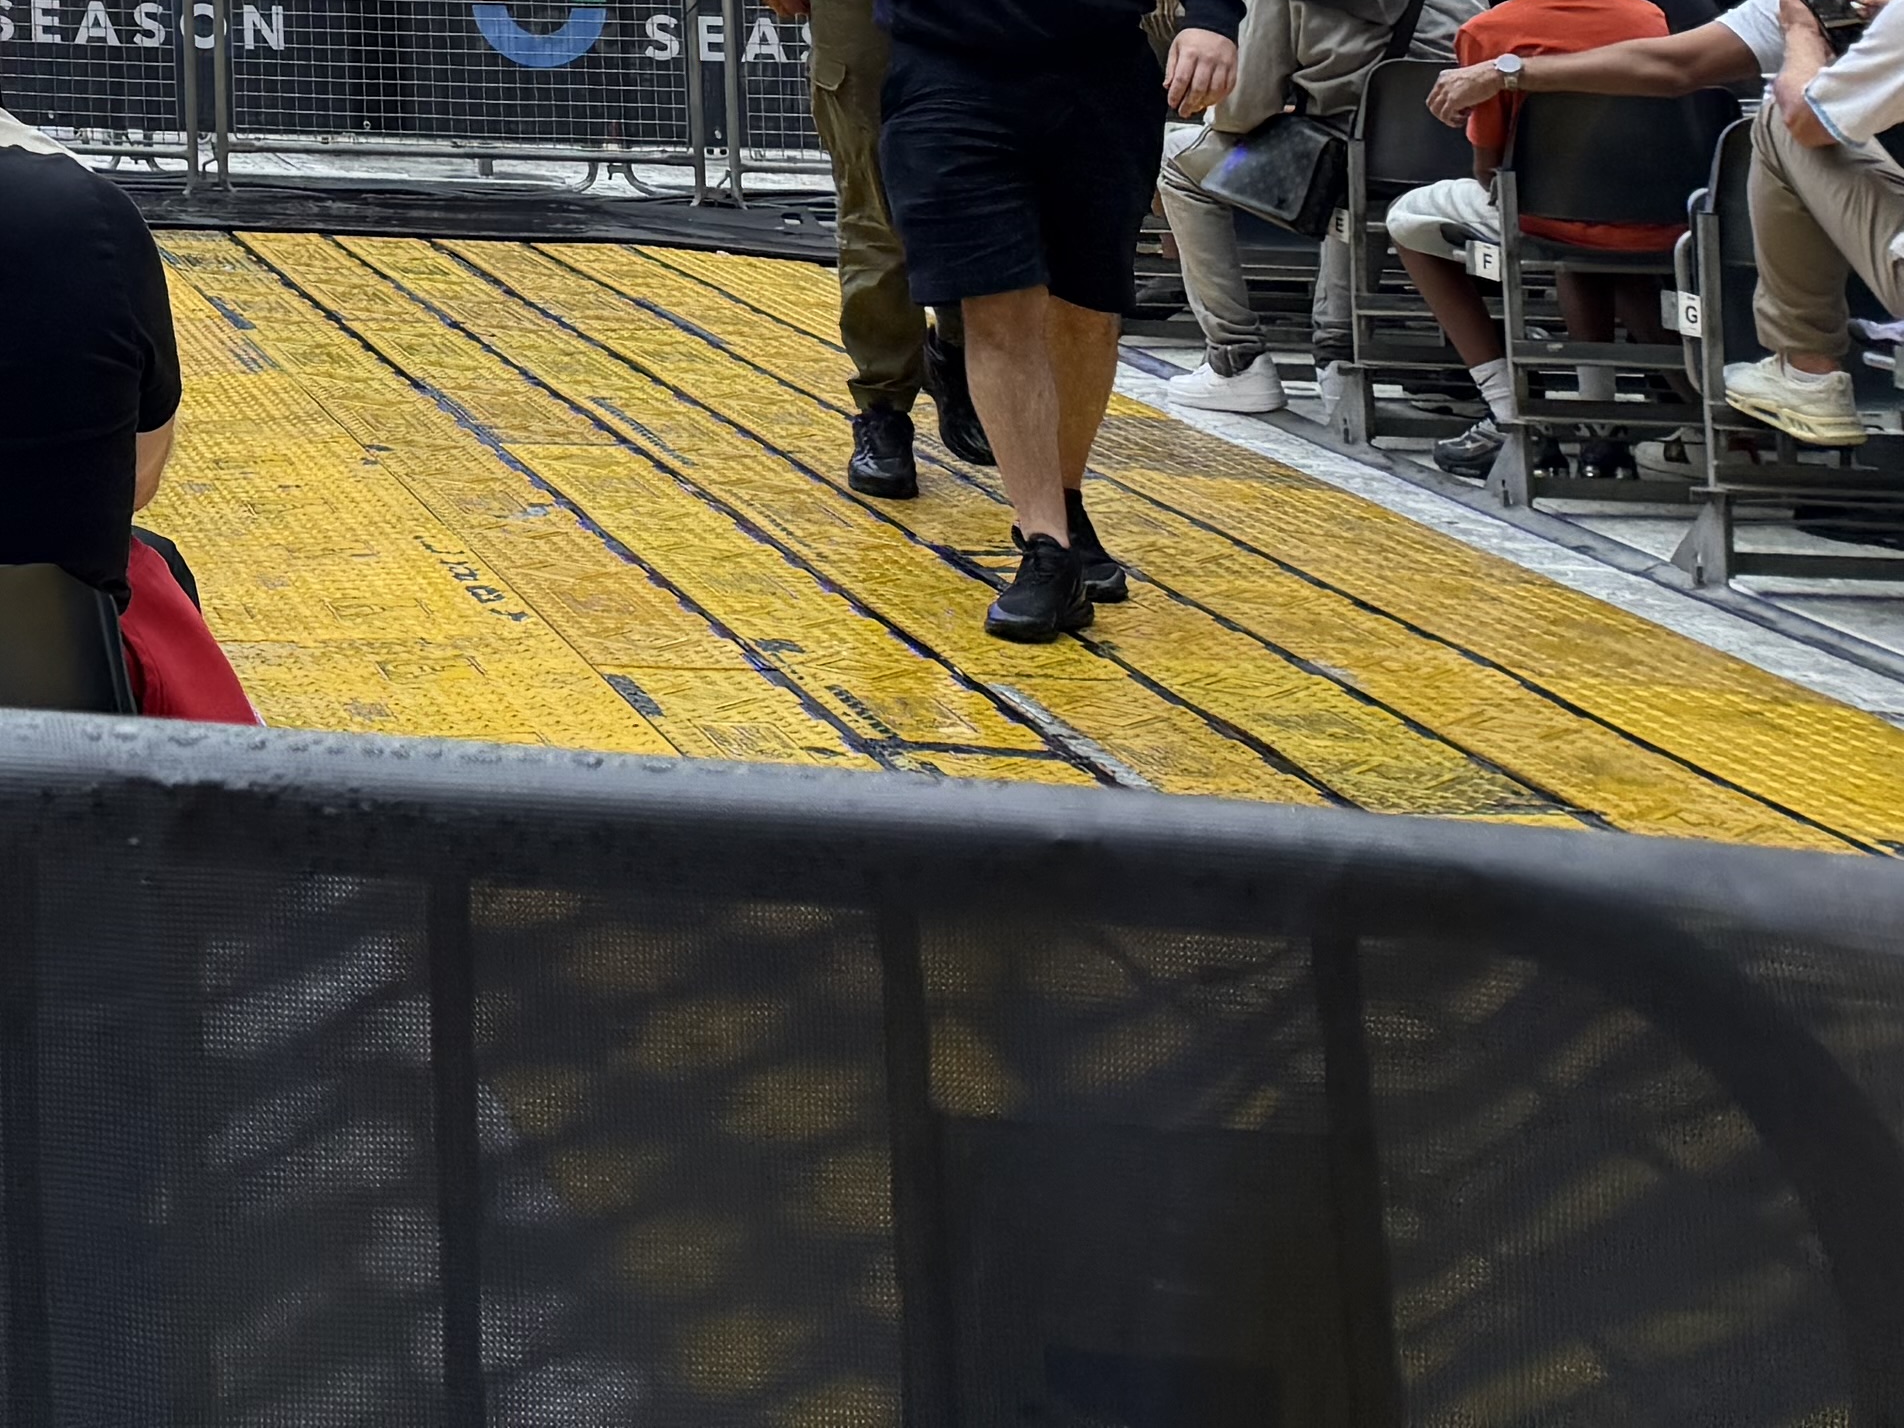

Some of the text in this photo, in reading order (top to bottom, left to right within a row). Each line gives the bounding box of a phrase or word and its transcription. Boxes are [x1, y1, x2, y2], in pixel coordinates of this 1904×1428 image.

[645, 14, 812, 63] SEA
[1335, 218, 1344, 233] E
[1483, 253, 1493, 270] F
[1685, 305, 1698, 323] G
